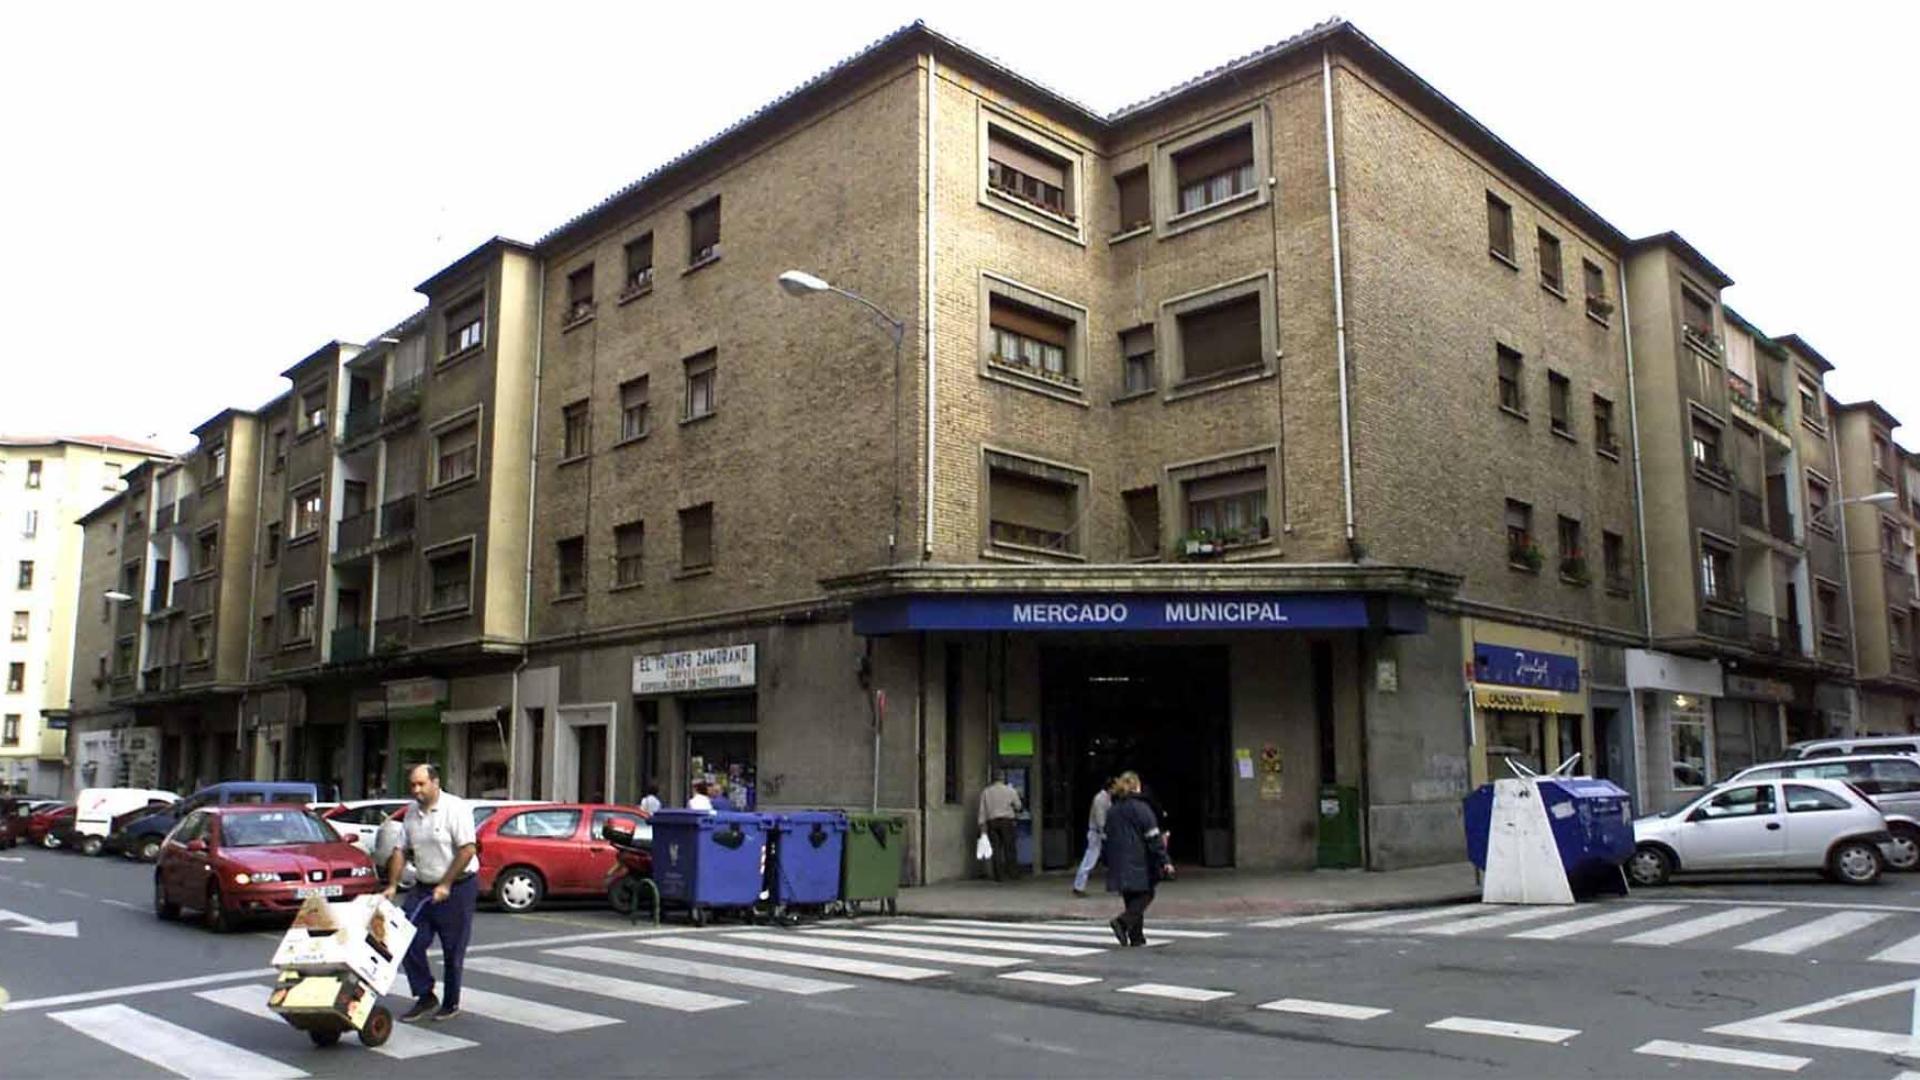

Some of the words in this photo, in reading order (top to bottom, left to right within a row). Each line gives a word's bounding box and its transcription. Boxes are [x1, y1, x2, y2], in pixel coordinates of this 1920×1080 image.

[1012, 603, 1128, 623] MERCADO
[1165, 602, 1288, 622] MUNICIPAL
[639, 656, 651, 672] EL
[655, 653, 693, 669] TRIUNFO
[696, 646, 749, 667] ZAMORANO
